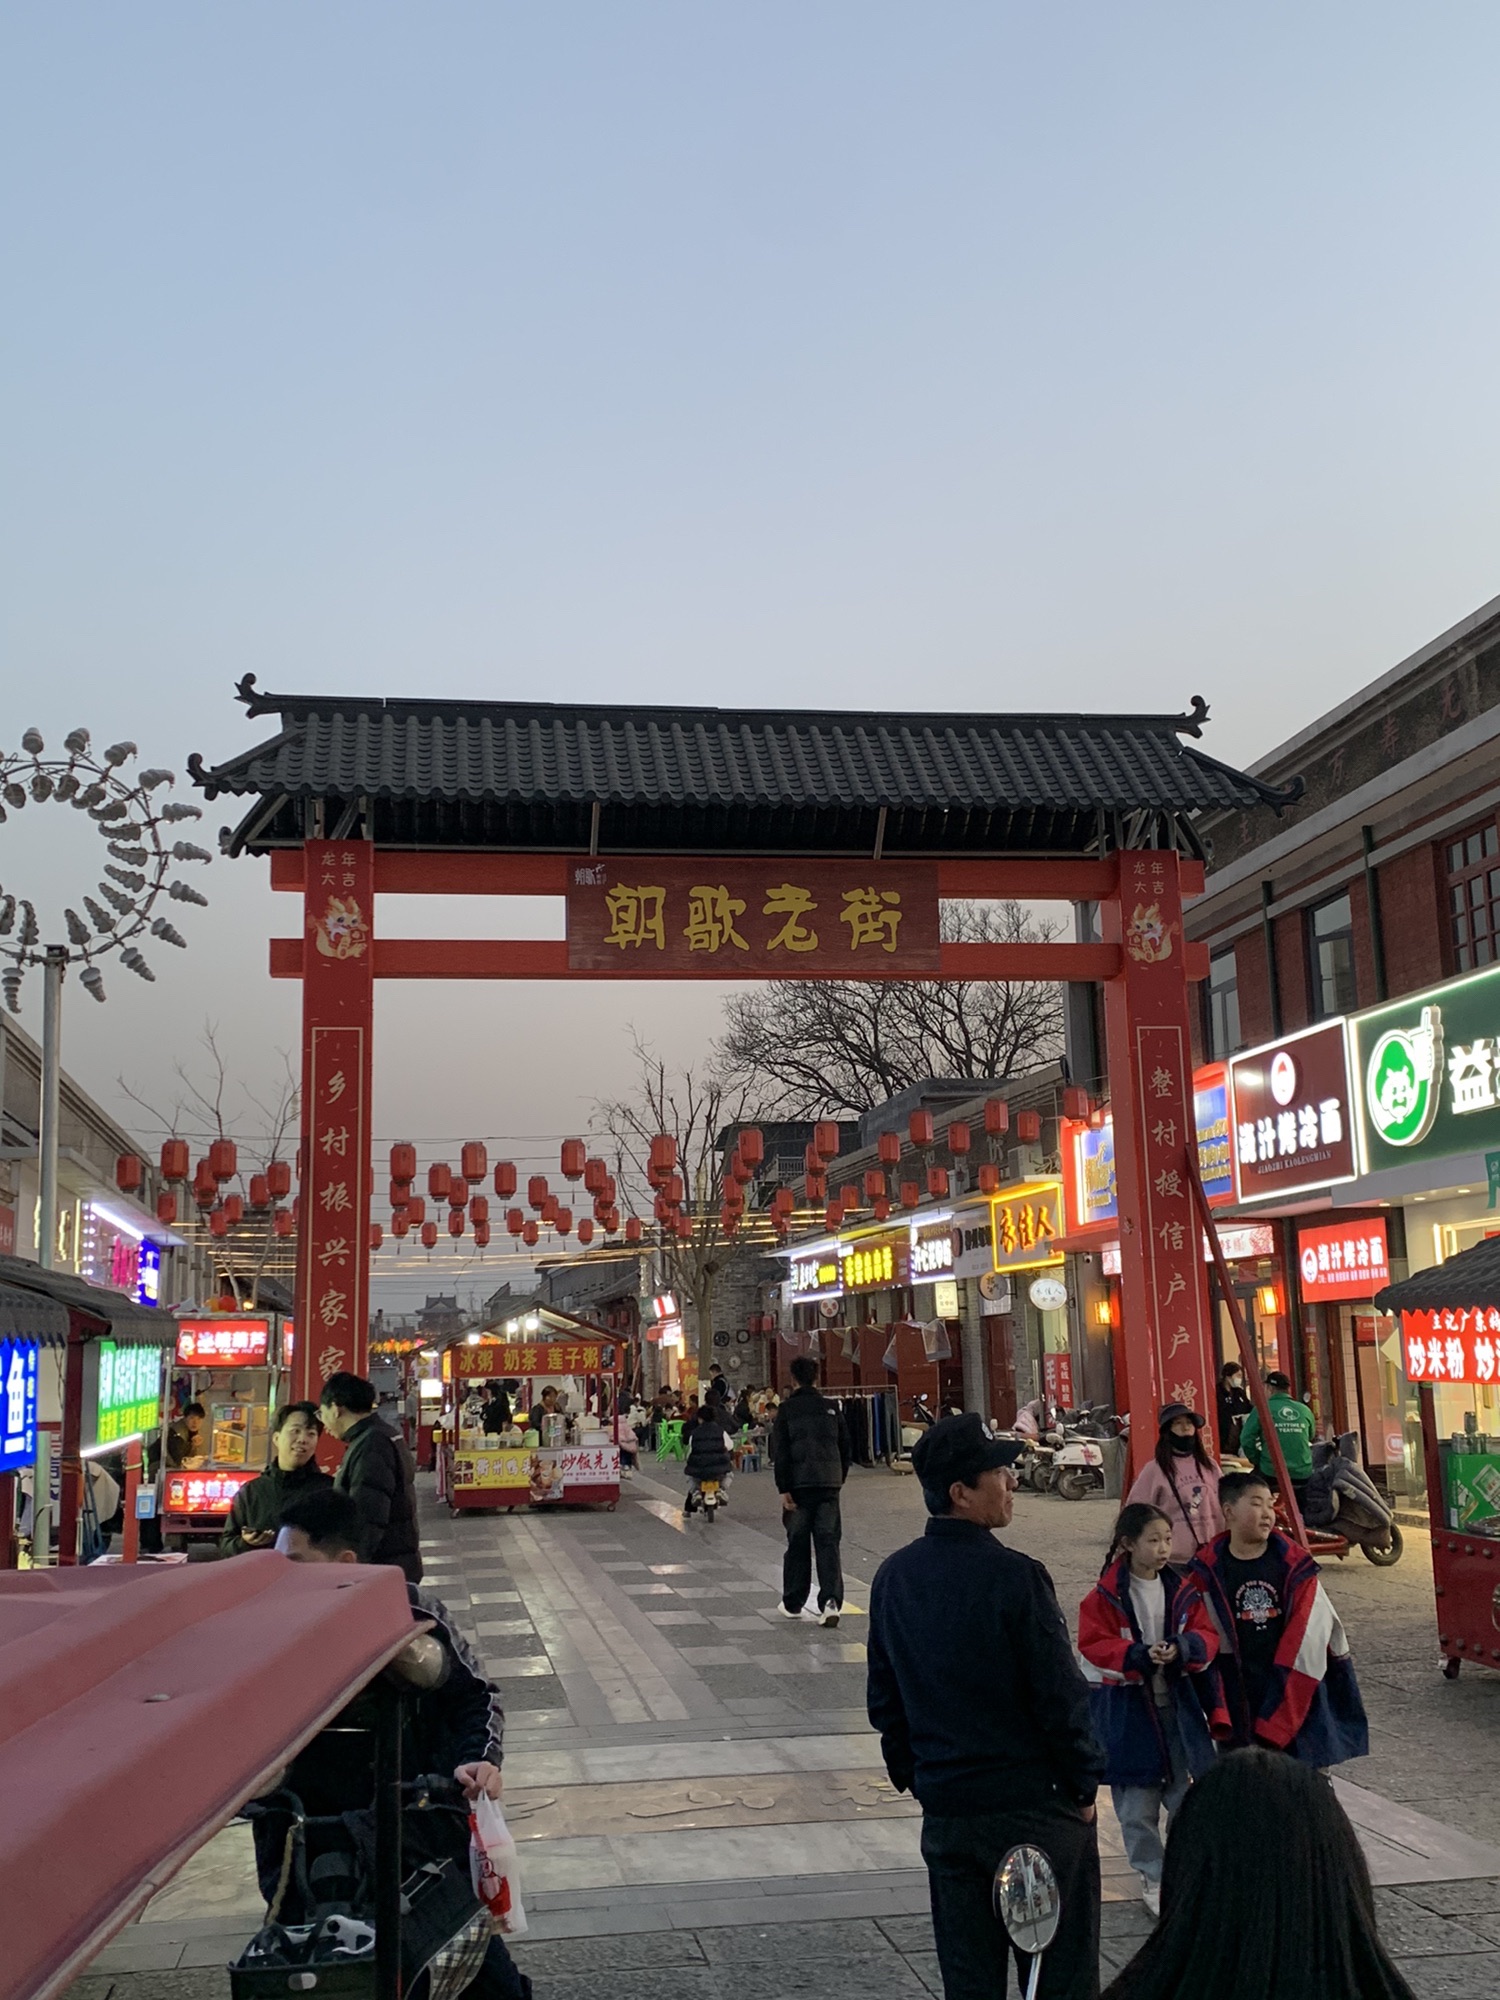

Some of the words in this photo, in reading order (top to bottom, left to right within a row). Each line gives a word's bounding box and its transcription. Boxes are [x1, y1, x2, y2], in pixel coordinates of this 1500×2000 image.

[321, 851, 357, 867] 龙年
[1133, 861, 1164, 876] 龙年
[321, 872, 356, 887] 大吉
[1134, 880, 1164, 895] 大吉
[603, 882, 902, 952] 朝歌老街
[459, 1351, 494, 1373] 冰粥
[504, 1350, 537, 1372] 奶茶
[547, 1346, 599, 1371] 莲子粥
[1407, 1336, 1465, 1380] 炒米粉
[187, 1480, 247, 1498] 冰糖葫
